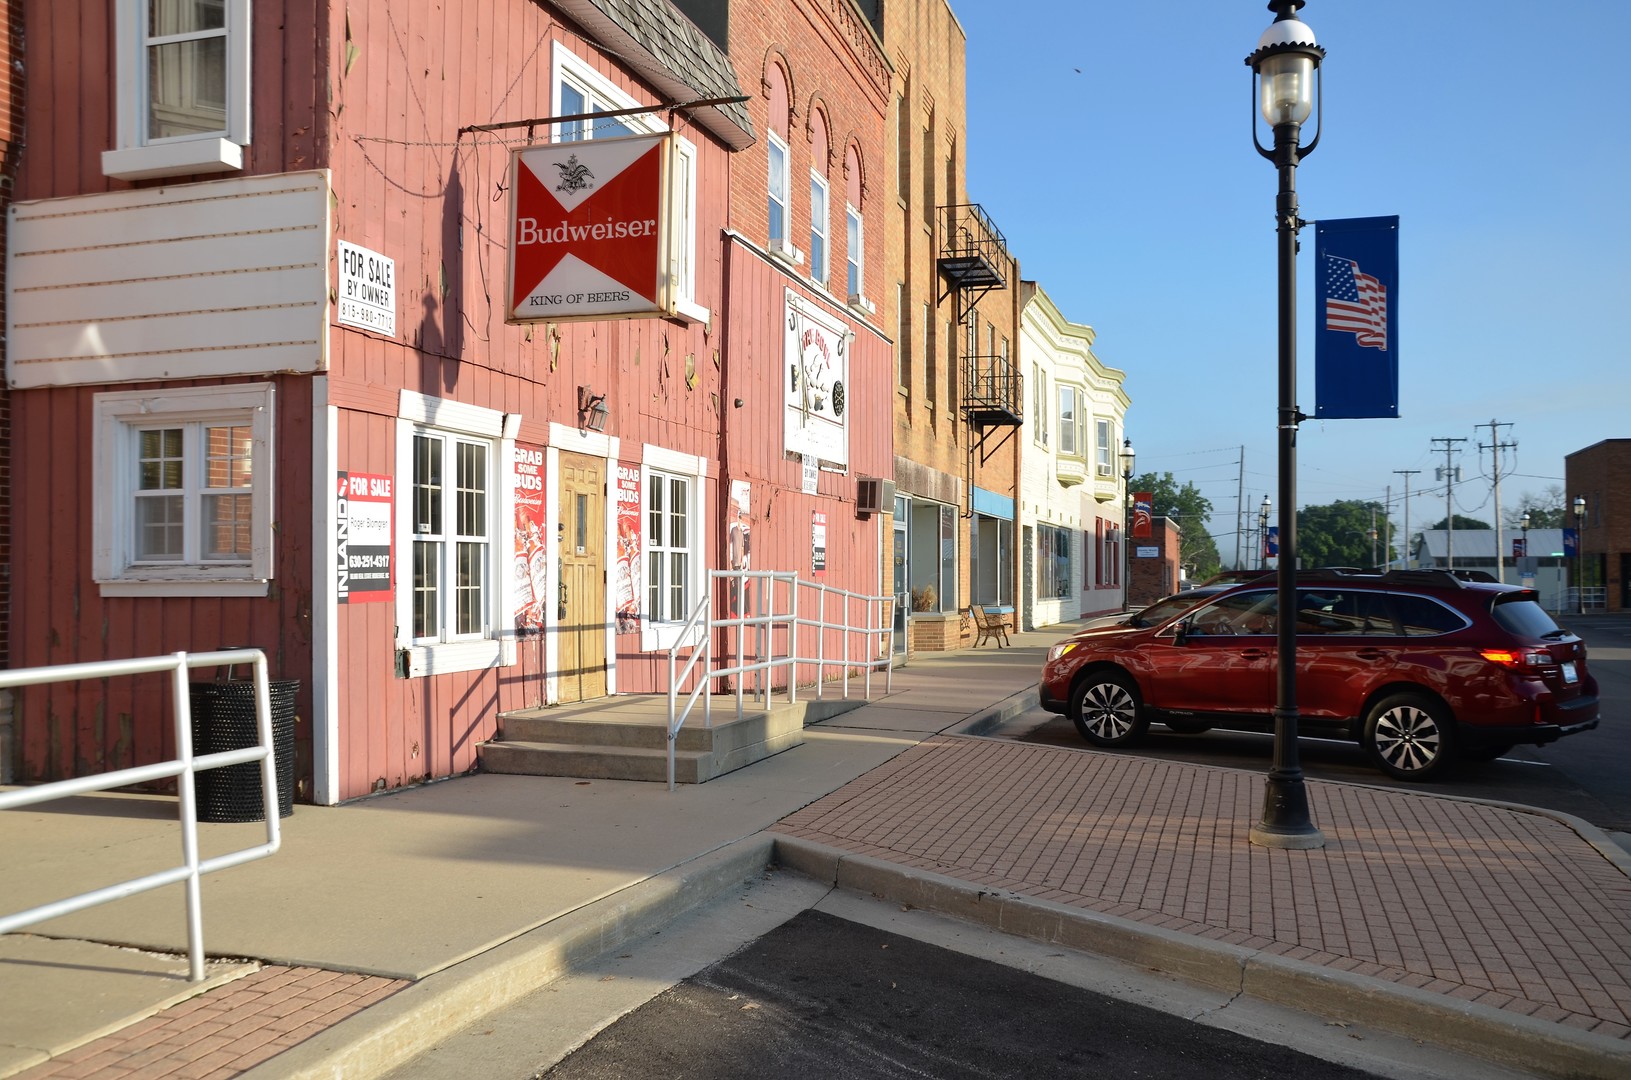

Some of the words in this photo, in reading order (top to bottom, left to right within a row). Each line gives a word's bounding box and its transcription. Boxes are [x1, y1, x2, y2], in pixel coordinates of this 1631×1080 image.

[517, 216, 655, 246] Budweiser
[343, 248, 364, 279] FOR
[368, 257, 391, 289] SALE
[347, 279, 358, 297] BY
[361, 283, 389, 308] OWNER
[529, 294, 563, 307] KING
[566, 293, 584, 305] OF
[587, 290, 630, 303] BEERS
[514, 447, 543, 466] GRAB
[518, 463, 538, 475] SOME
[617, 466, 640, 482] GRAB
[349, 476, 368, 496] FOR
[370, 478, 391, 497] SALE
[514, 473, 542, 491] BUDS
[621, 480, 637, 490] SOME
[617, 488, 639, 504] BUDS
[337, 498, 349, 598] INLAND
